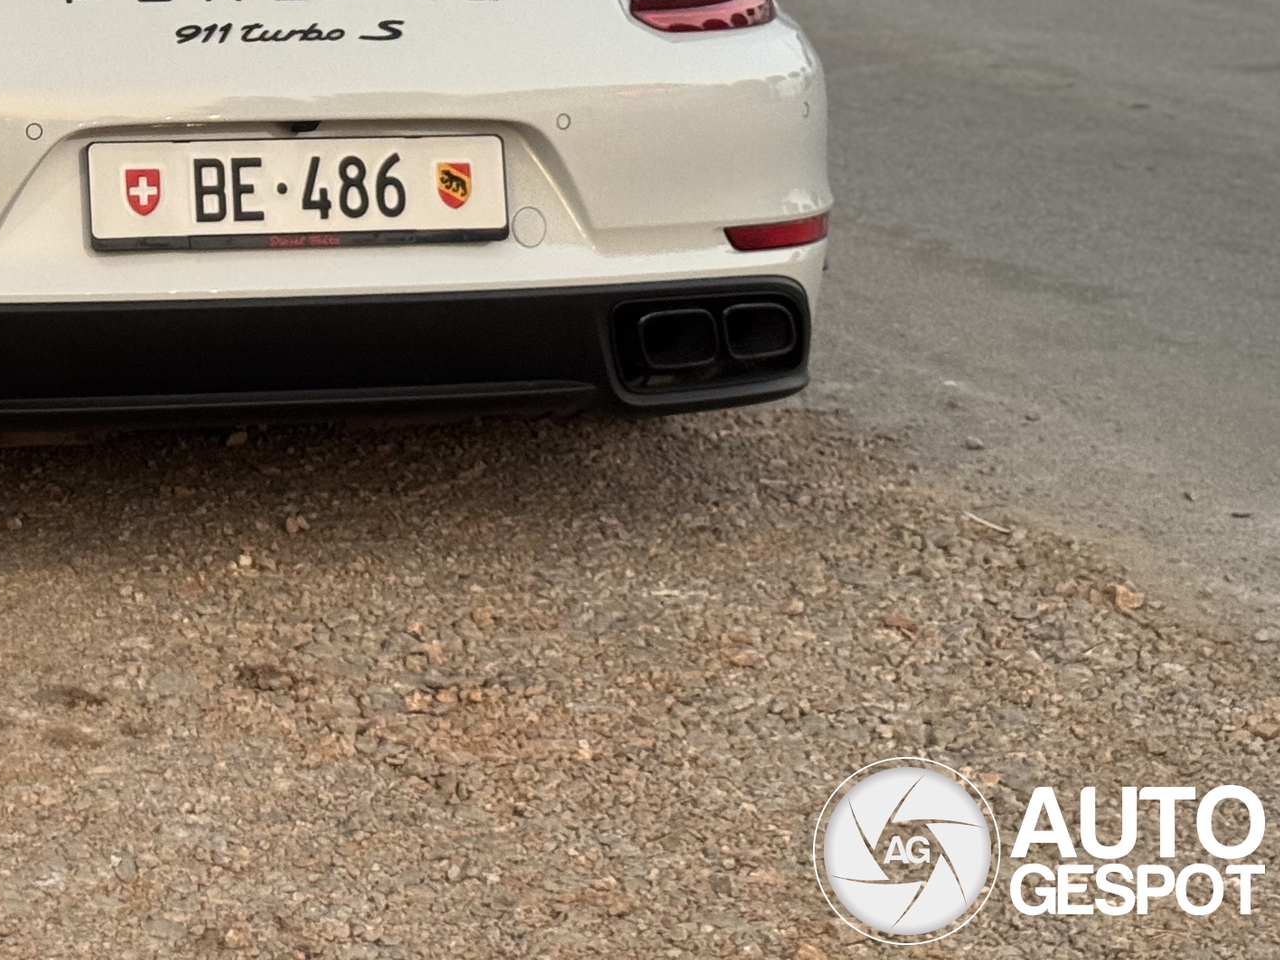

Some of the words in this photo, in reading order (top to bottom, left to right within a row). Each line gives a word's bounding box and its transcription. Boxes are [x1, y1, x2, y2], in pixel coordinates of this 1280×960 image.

[174, 22, 233, 44] 911
[240, 22, 346, 43] turbo
[357, 19, 405, 41] S
